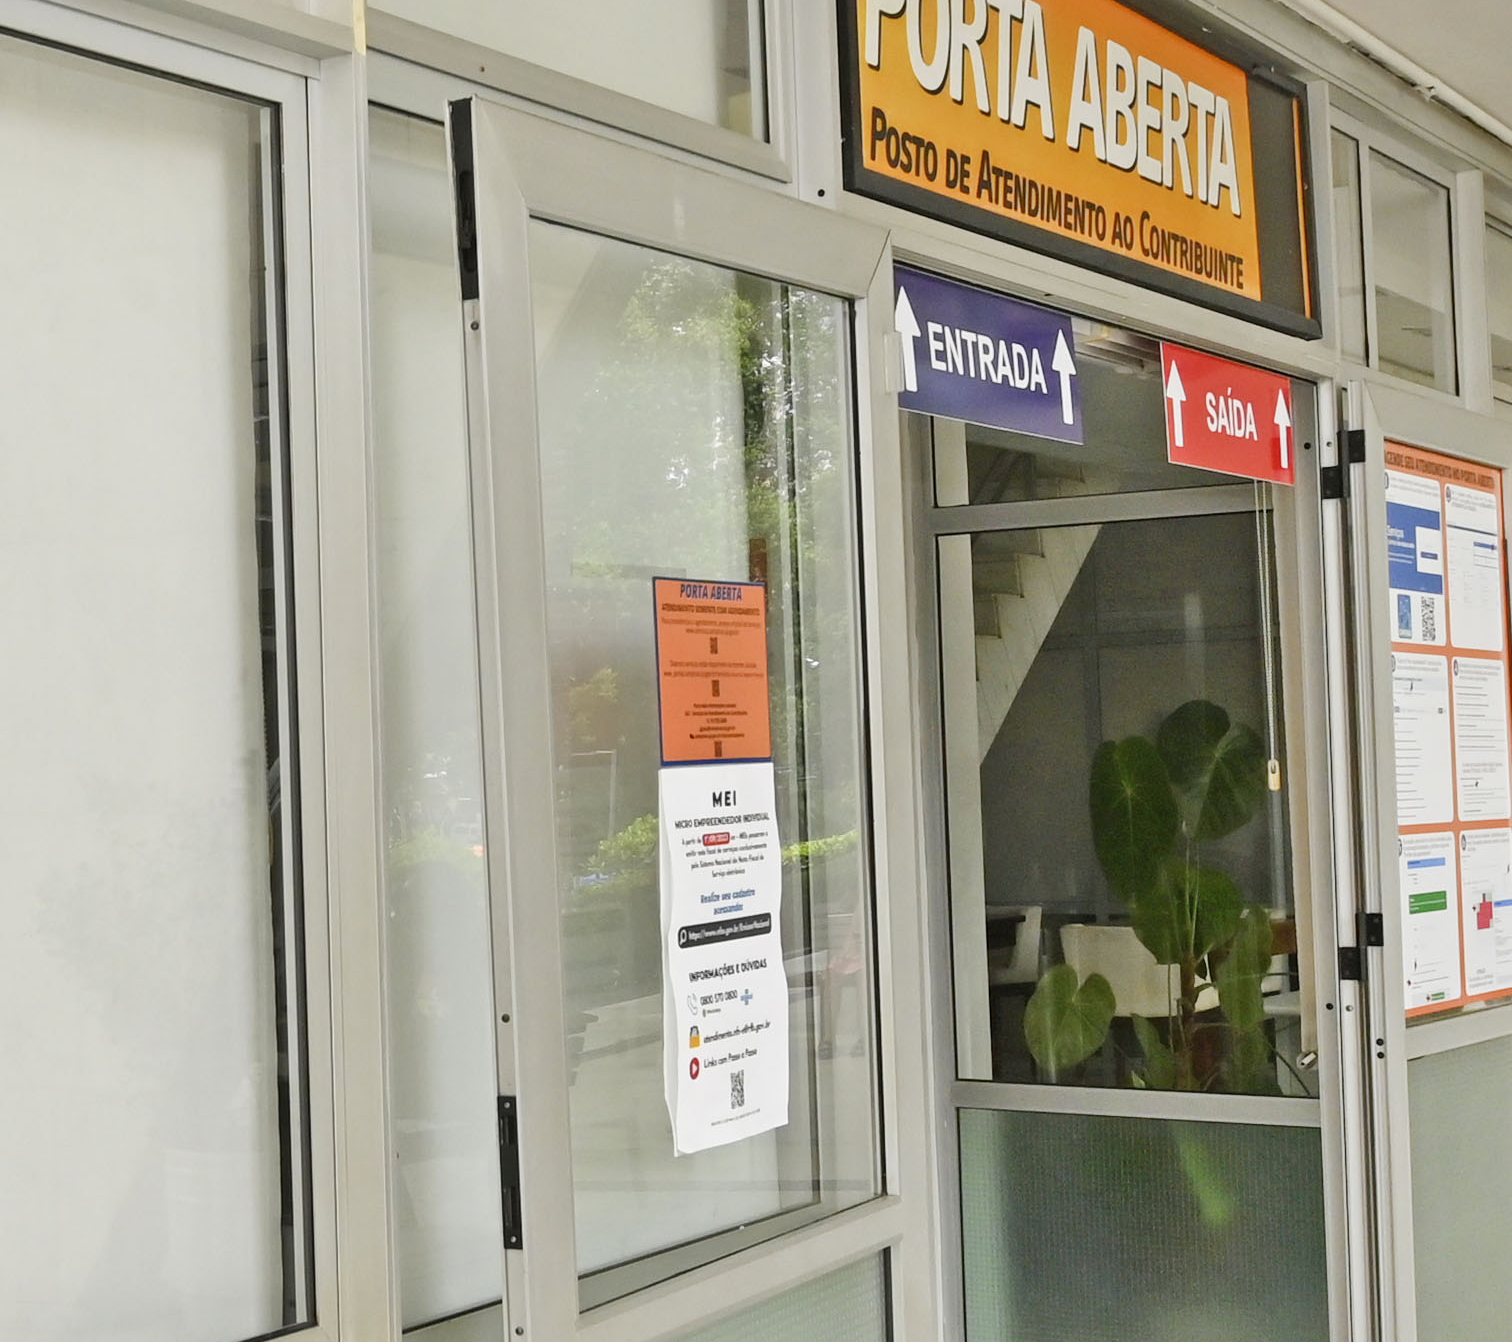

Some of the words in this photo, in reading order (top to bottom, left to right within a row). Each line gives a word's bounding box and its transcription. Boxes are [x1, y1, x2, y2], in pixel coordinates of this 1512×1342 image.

[1066, 24, 1243, 218] ABERTA
[870, 106, 940, 183] POSTO
[977, 150, 1109, 243] ATENDIMENTO
[1139, 211, 1246, 291] CONTRIBUINTE
[927, 322, 1048, 394] ENTRADA
[1206, 388, 1258, 442] SAÍDA
[680, 583, 708, 599] PORTA
[710, 586, 742, 601] ABERTA
[712, 790, 736, 807] MEI
[675, 819, 692, 829] MICRO
[694, 815, 741, 828] EMPREENDEDOR
[743, 812, 770, 823] INDIVIDUAL
[689, 963, 735, 982] INFORMAÇÕES
[736, 965, 740, 973] E
[741, 958, 767, 972] DÚVIDAS
